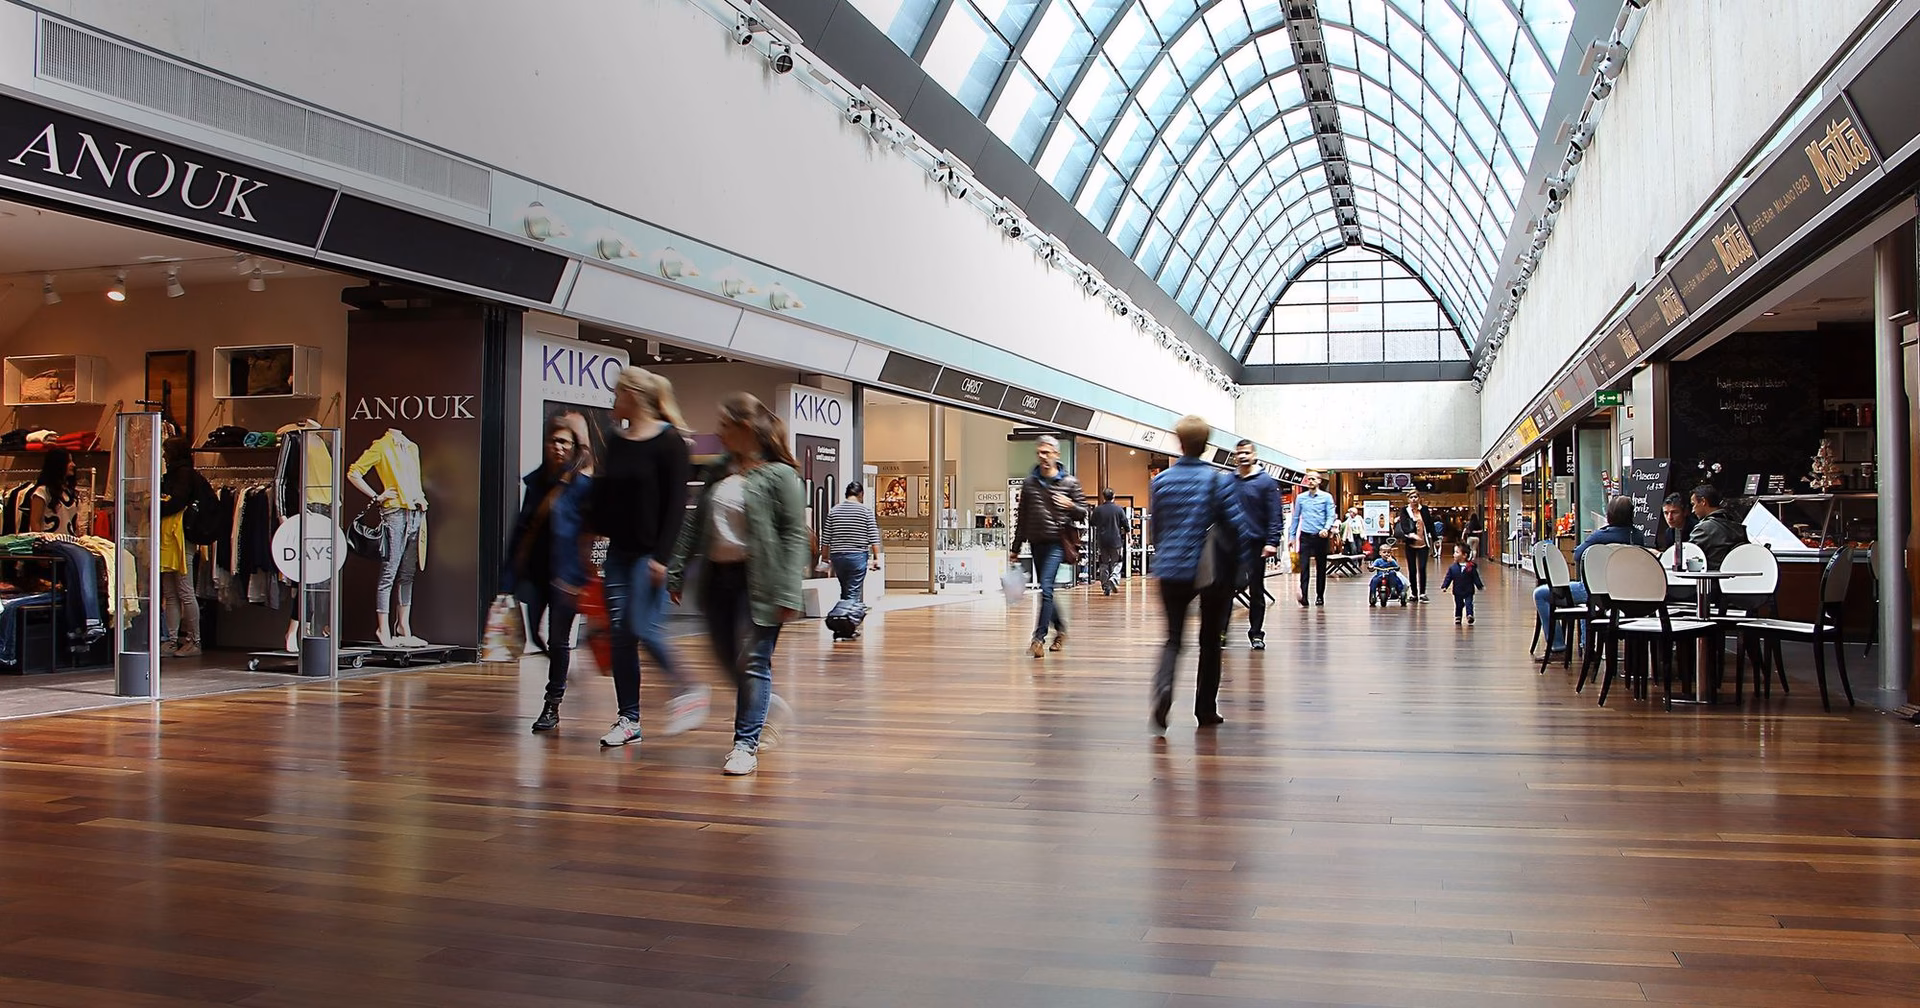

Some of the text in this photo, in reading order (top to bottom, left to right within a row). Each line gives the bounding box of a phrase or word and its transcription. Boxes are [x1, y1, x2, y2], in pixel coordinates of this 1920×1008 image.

[8, 122, 269, 223] ANOUK
[1804, 117, 1871, 195] Motta
[1792, 174, 1811, 197] 1928
[1711, 222, 1753, 275] Motta
[1655, 286, 1685, 326] Motta
[542, 345, 623, 393] KIKO
[961, 377, 984, 394] CHRIST
[350, 395, 476, 420] ANOUK
[794, 392, 842, 426] KIKO
[1021, 394, 1040, 409] CHRIST
